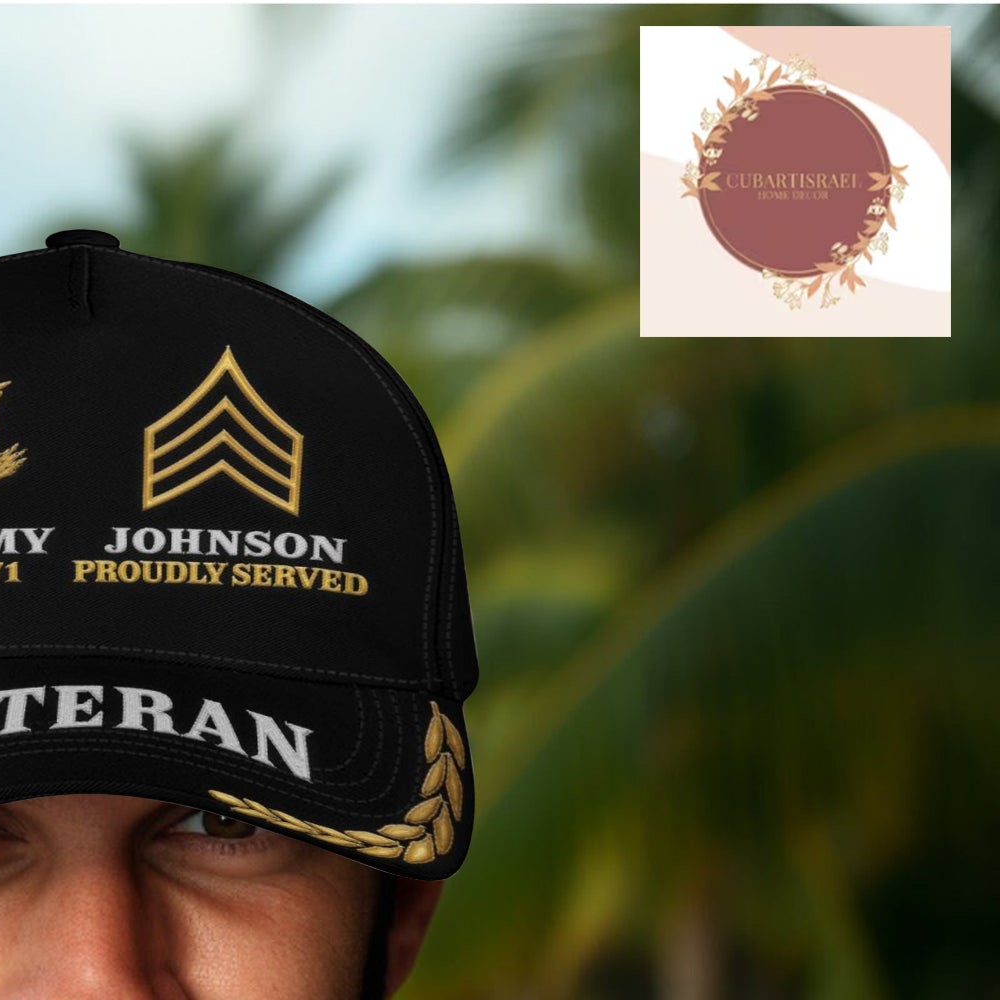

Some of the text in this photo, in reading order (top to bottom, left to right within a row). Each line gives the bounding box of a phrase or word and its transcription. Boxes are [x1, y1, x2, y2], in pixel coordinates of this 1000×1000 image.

[104, 526, 348, 564] JOHNSON
[72, 559, 370, 597] PROUDLY SERVED
